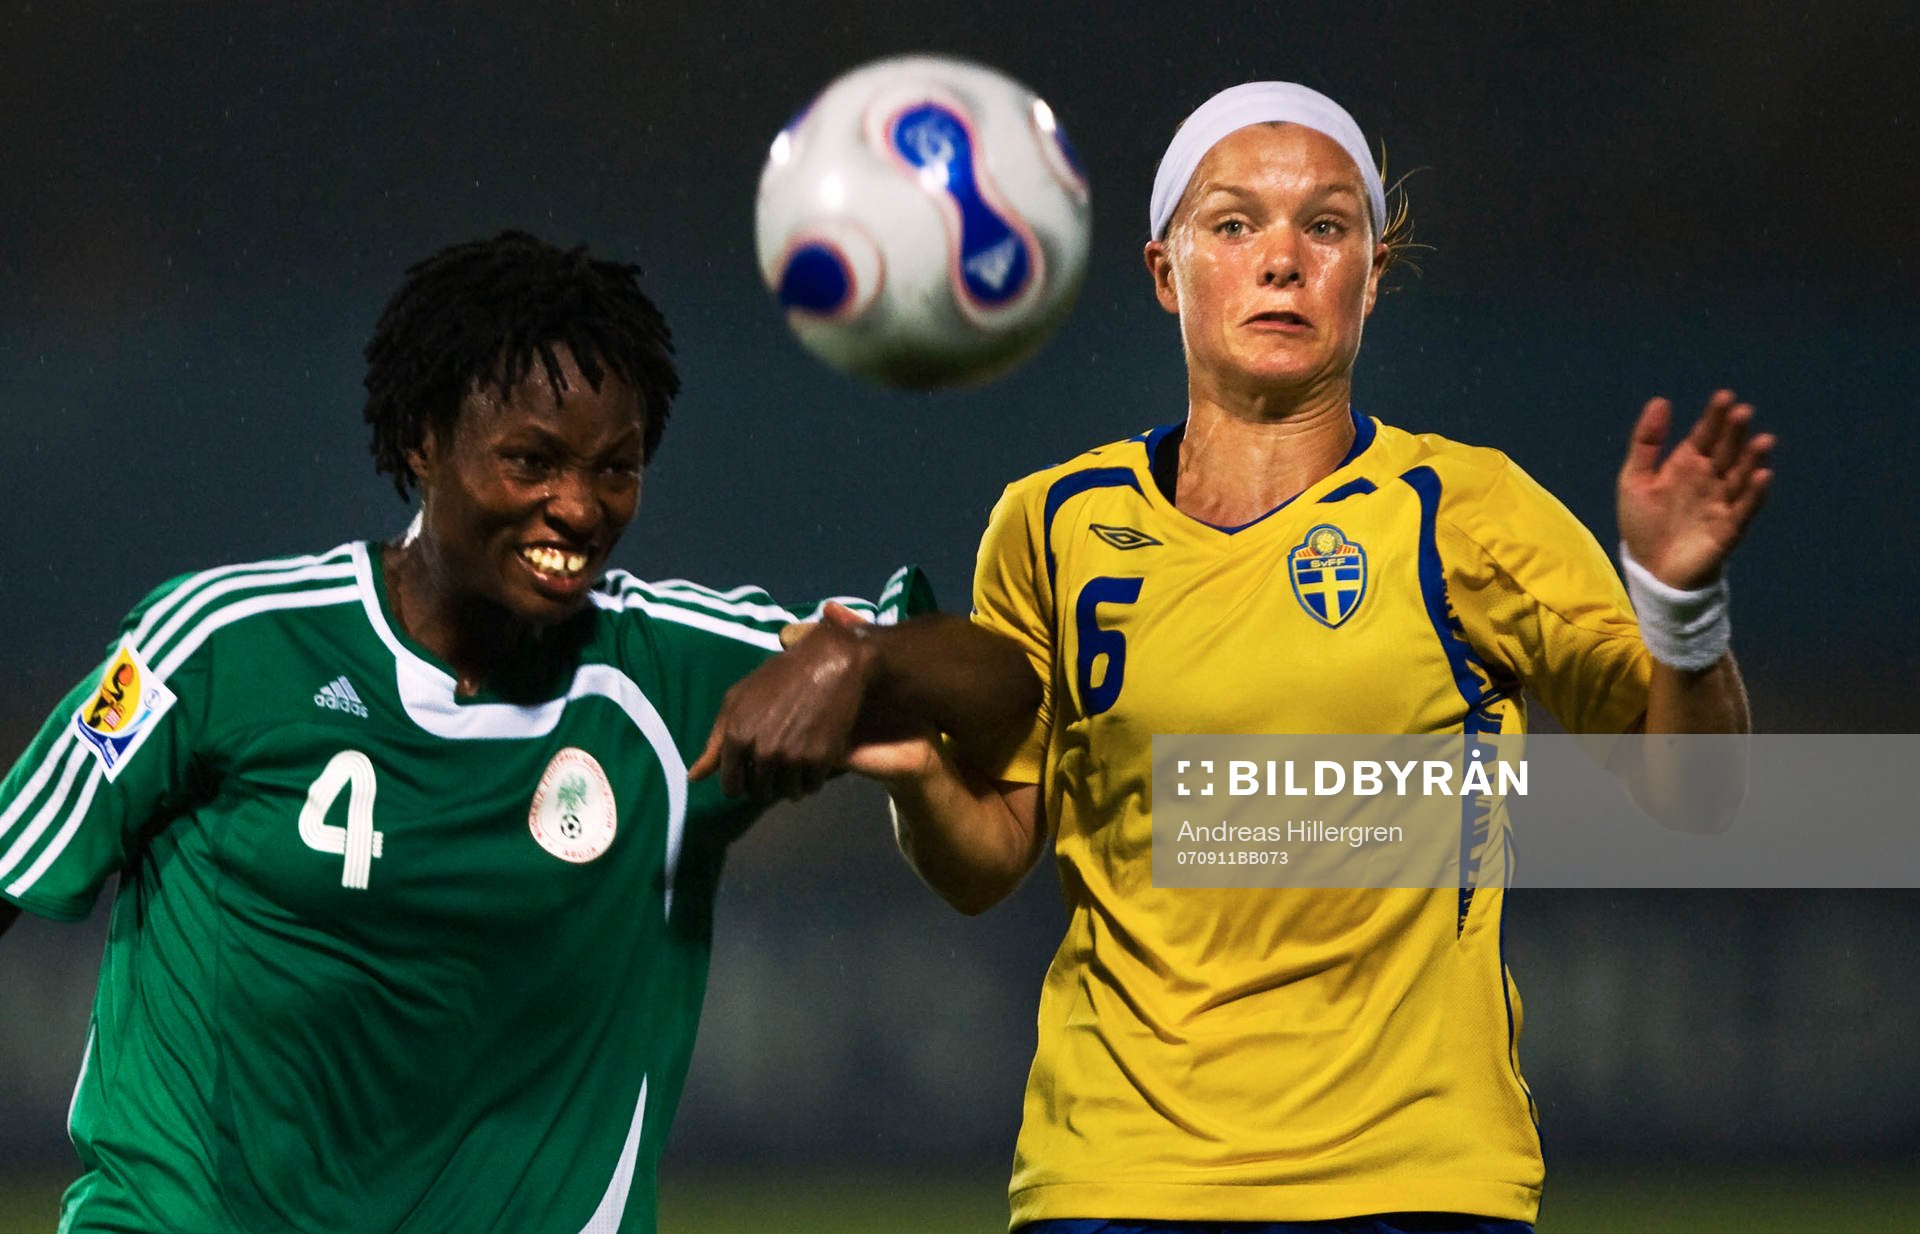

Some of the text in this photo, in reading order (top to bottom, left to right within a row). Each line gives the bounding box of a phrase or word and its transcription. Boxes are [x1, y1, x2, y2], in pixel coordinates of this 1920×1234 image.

[1310, 557, 1346, 568] SvFF
[1076, 576, 1144, 719] 6
[313, 694, 368, 719] adidas
[298, 749, 383, 889] 4
